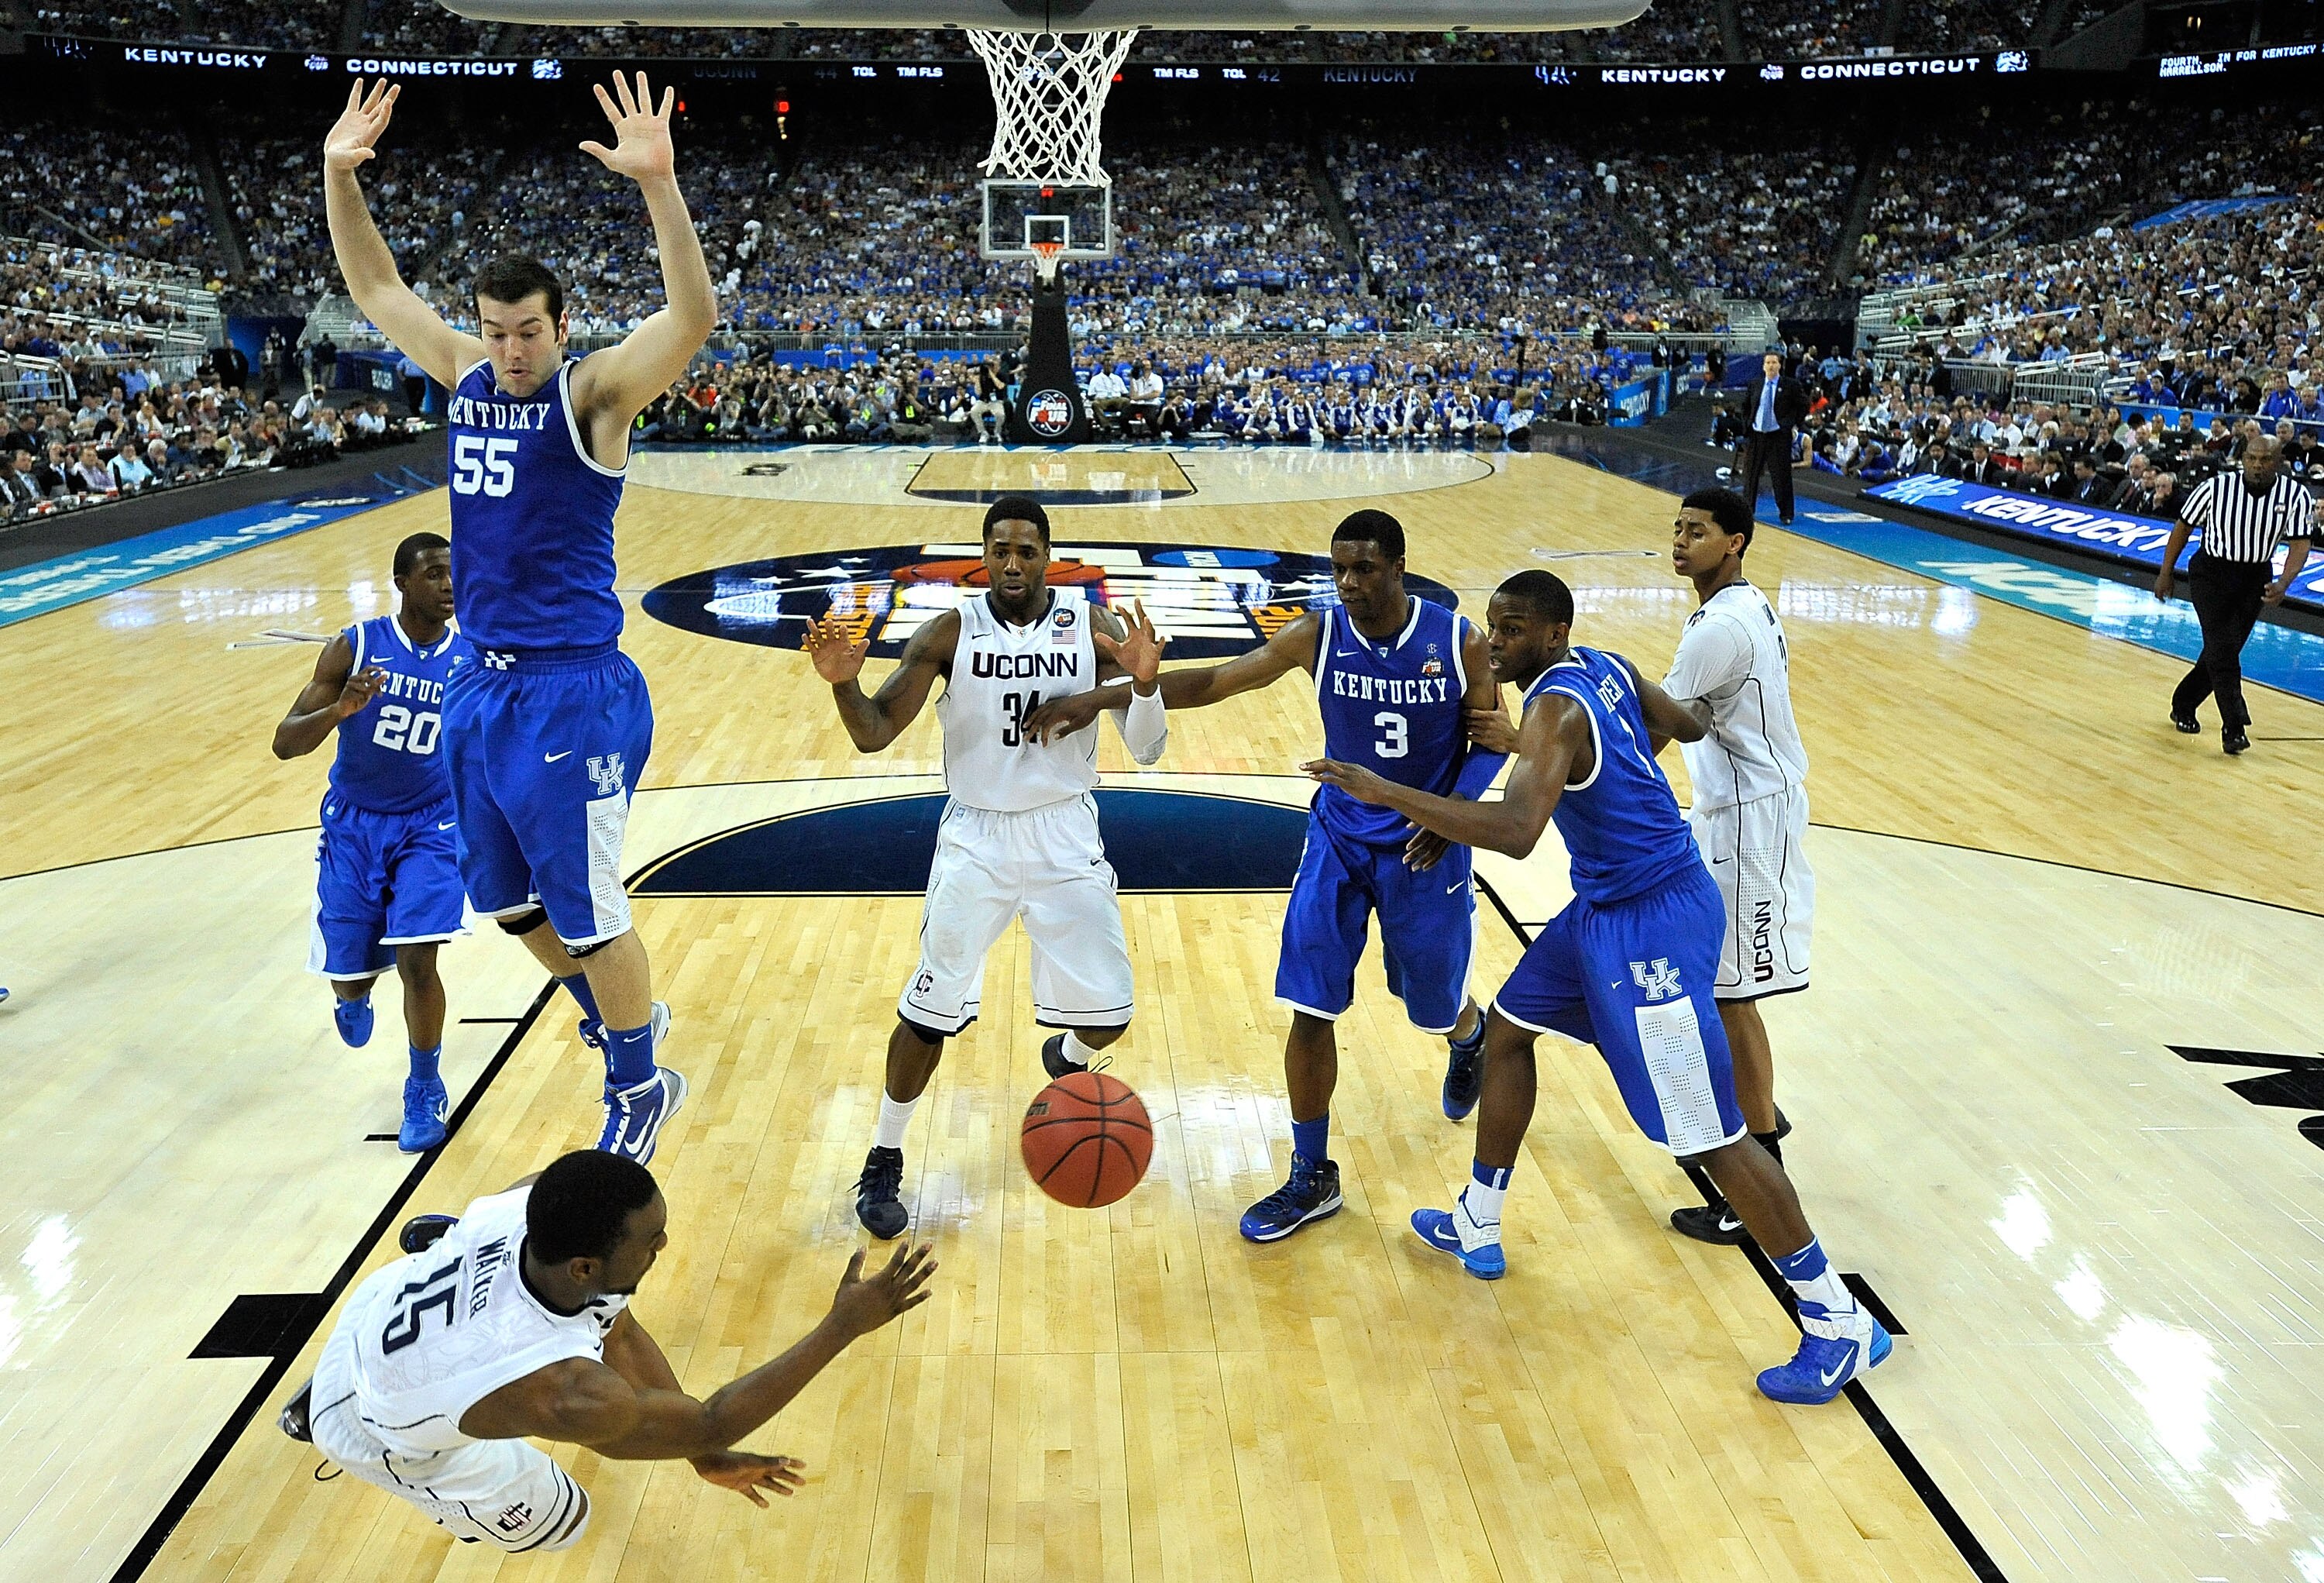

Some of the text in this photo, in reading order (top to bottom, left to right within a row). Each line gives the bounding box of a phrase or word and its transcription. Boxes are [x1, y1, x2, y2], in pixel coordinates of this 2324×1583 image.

[125, 47, 267, 69] KENTUCKY
[2218, 52, 2231, 63] IN
[2236, 50, 2257, 61] FOR
[2262, 44, 2316, 59] KENTUCKY
[346, 59, 518, 76] CONNECTICUT
[852, 67, 877, 77] TOL
[896, 67, 944, 77] TM FLS
[1153, 68, 1199, 78] TM FLS
[1222, 68, 1246, 79] TOL
[1258, 68, 1280, 82] 42
[1324, 67, 1418, 83] KENTUCKY
[1601, 68, 1727, 83] KENTUCKY
[1800, 57, 1981, 80] CONNECTICUT
[453, 435, 518, 497] 55
[1961, 494, 2202, 552] KENTUCKY
[971, 652, 1077, 680] UCONN
[1333, 670, 1446, 704] KENTUCKY
[372, 704, 442, 755] 20
[1002, 690, 1040, 747] 34
[1374, 711, 1408, 758] 3
[1752, 900, 1774, 983] UCONN
[1629, 958, 1683, 1000] UK
[383, 1254, 464, 1354] 15
